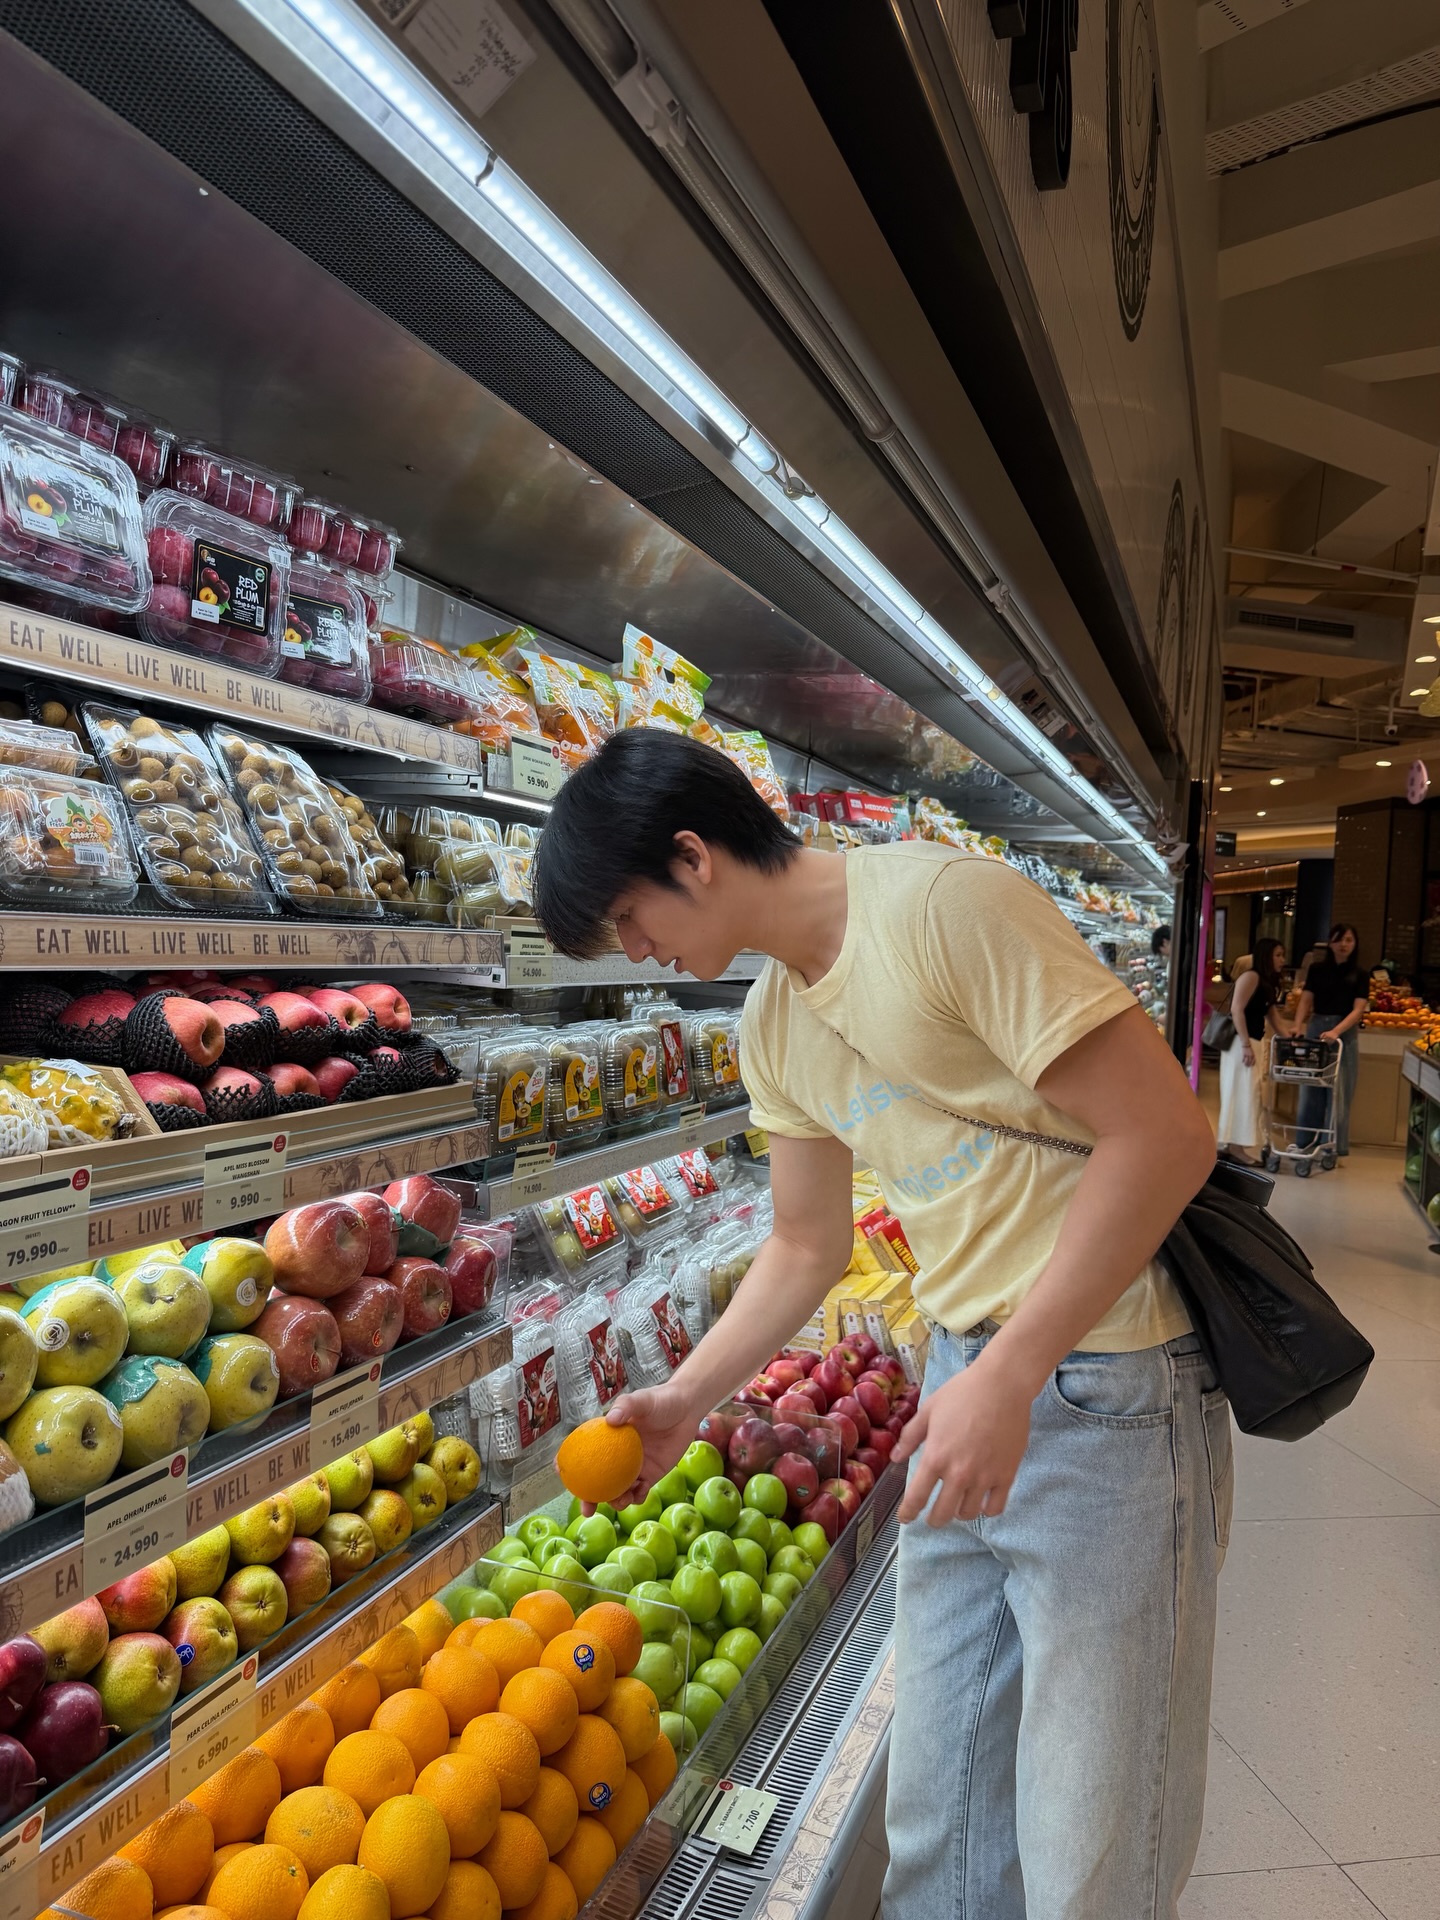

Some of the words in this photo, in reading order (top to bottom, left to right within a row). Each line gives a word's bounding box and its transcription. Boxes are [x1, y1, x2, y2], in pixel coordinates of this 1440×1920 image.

[72, 498, 106, 519] PLUM
[235, 587, 259, 604] PLUM
[238, 574, 258, 591] RED
[10, 620, 45, 652] EAT
[58, 633, 103, 668] WELL
[126, 651, 160, 683] LIVE
[170, 663, 208, 694] WELL
[227, 679, 242, 702] BE
[251, 684, 284, 713] WELL
[527, 775, 549, 789] 59.900
[36, 928, 71, 953] EAT
[85, 929, 130, 954] WELL
[153, 931, 186, 955] LIVE
[197, 932, 235, 955] WELL
[253, 934, 269, 955] BE
[278, 934, 311, 955] WELL
[230, 1191, 260, 1210] 9.990
[21, 1212, 41, 1223] FRUIT
[88, 1219, 115, 1247] ELL
[138, 1205, 171, 1235] LIVE
[182, 1197, 203, 1225] WE
[7, 1240, 57, 1268] 79.990
[328, 1407, 340, 1417] APEL
[330, 1422, 361, 1448] 15.490
[213, 1473, 250, 1512] WELL
[268, 1454, 283, 1482] BE
[292, 1440, 310, 1469] WE
[106, 1517, 122, 1531] APEL
[123, 1506, 144, 1522] OHRIN
[143, 1494, 167, 1513] JEPANG
[114, 1531, 159, 1568] 24.990
[55, 1558, 83, 1599] EA
[261, 1687, 276, 1719] BE
[284, 1658, 316, 1700] WELL
[187, 1726, 201, 1741] PEAR
[201, 1713, 221, 1731] CELINA
[221, 1698, 239, 1715] AFRICA
[197, 1736, 229, 1771] 6.990
[742, 1809, 760, 1831] 7.700
[51, 1833, 86, 1885] EAT
[98, 1793, 142, 1845] WELL
